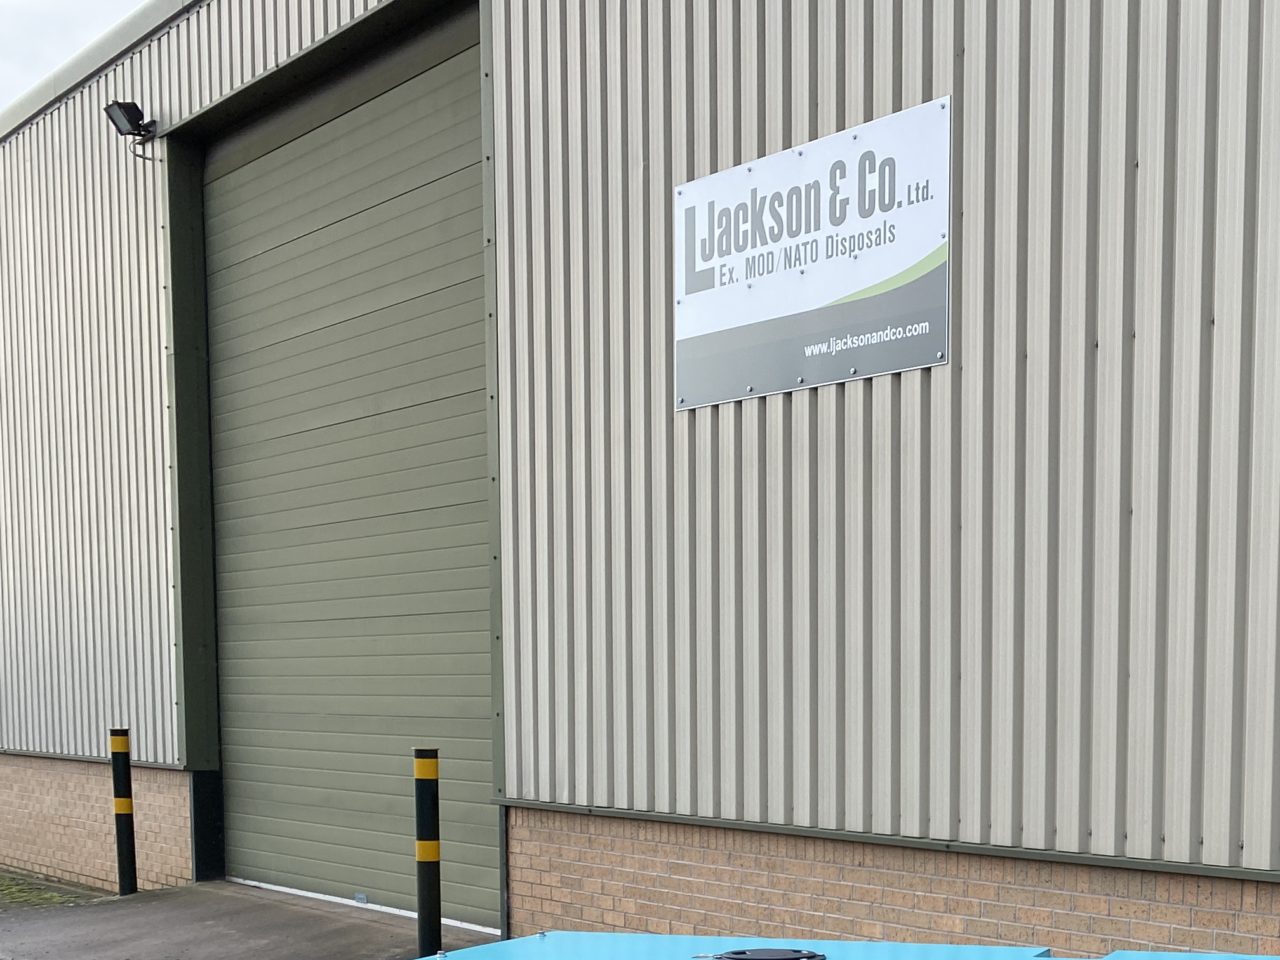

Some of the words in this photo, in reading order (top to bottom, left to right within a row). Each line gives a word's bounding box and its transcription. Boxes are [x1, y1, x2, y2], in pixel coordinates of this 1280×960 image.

[829, 159, 850, 227] &
[858, 150, 902, 219] Co.
[907, 179, 934, 206] Ltd.
[719, 263, 739, 287] Ex.
[745, 238, 818, 281] MOD/NATO
[826, 219, 896, 260] Disposals
[804, 320, 929, 357] www.ljacksonandco.com
